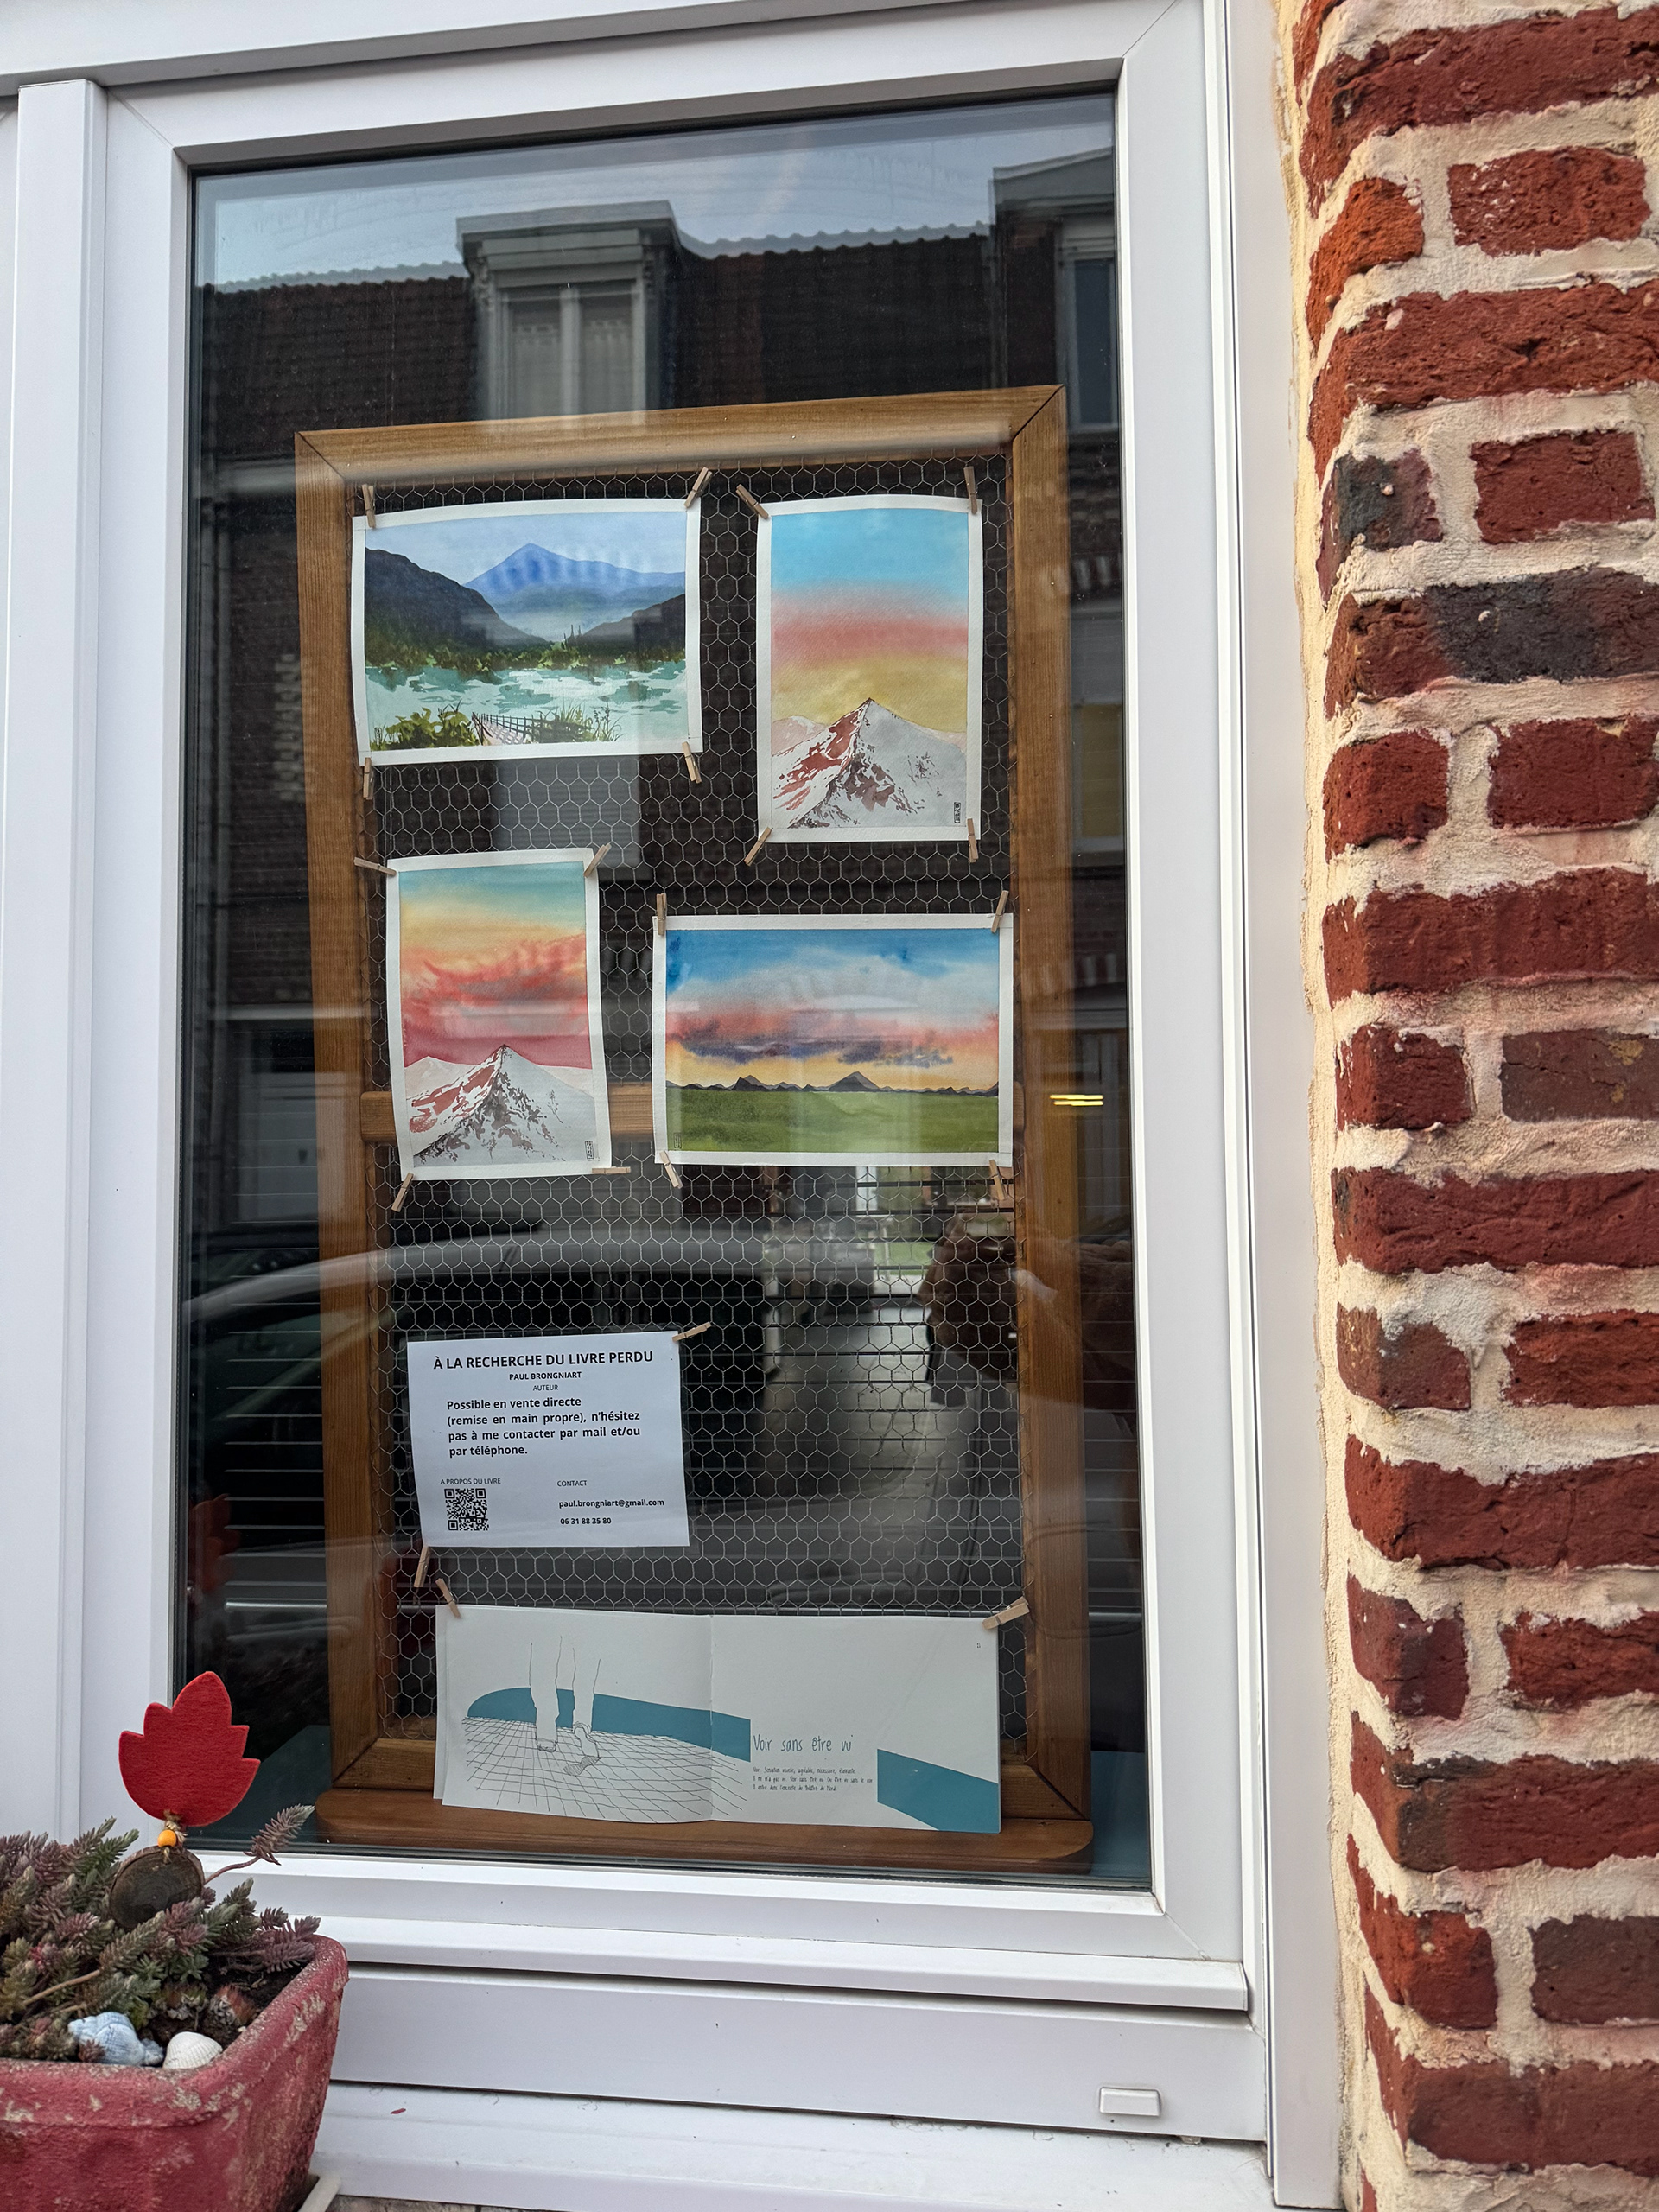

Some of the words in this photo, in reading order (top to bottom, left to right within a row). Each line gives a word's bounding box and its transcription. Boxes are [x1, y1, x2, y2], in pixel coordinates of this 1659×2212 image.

[433, 1355, 443, 1370] À
[446, 1357, 463, 1370] LA
[466, 1354, 543, 1369] RECHERCHE
[545, 1353, 566, 1365] DU
[569, 1352, 606, 1365] LIVRE
[608, 1351, 654, 1363] PERDU
[508, 1372, 530, 1381] PAUL
[531, 1371, 582, 1380] BRONGNIART
[532, 1383, 559, 1392] AUTEUR
[447, 1399, 491, 1410] Possible
[493, 1400, 507, 1409] en
[509, 1398, 541, 1408] vente
[543, 1396, 582, 1408] directe
[447, 1414, 488, 1427] (remise
[492, 1414, 506, 1425] en
[511, 1413, 539, 1424] main
[543, 1412, 587, 1426] propre),
[591, 1410, 640, 1422] n'hésitez
[448, 1431, 467, 1445] pas
[471, 1429, 478, 1440] à
[481, 1429, 499, 1440] me
[503, 1428, 556, 1440] contacter
[559, 1428, 578, 1440] par
[582, 1427, 607, 1438] mail
[610, 1426, 641, 1437] et/ou
[448, 1446, 467, 1459] par
[470, 1444, 528, 1458] téléphone.
[558, 1498, 665, 1510] paul.brongniart@gmail.com
[581, 1516, 591, 1525] 88
[592, 1516, 601, 1525] 35
[753, 1733, 772, 1751] Voir
[780, 1738, 804, 1752] sans
[811, 1735, 832, 1751] être
[841, 1740, 852, 1752] vu
